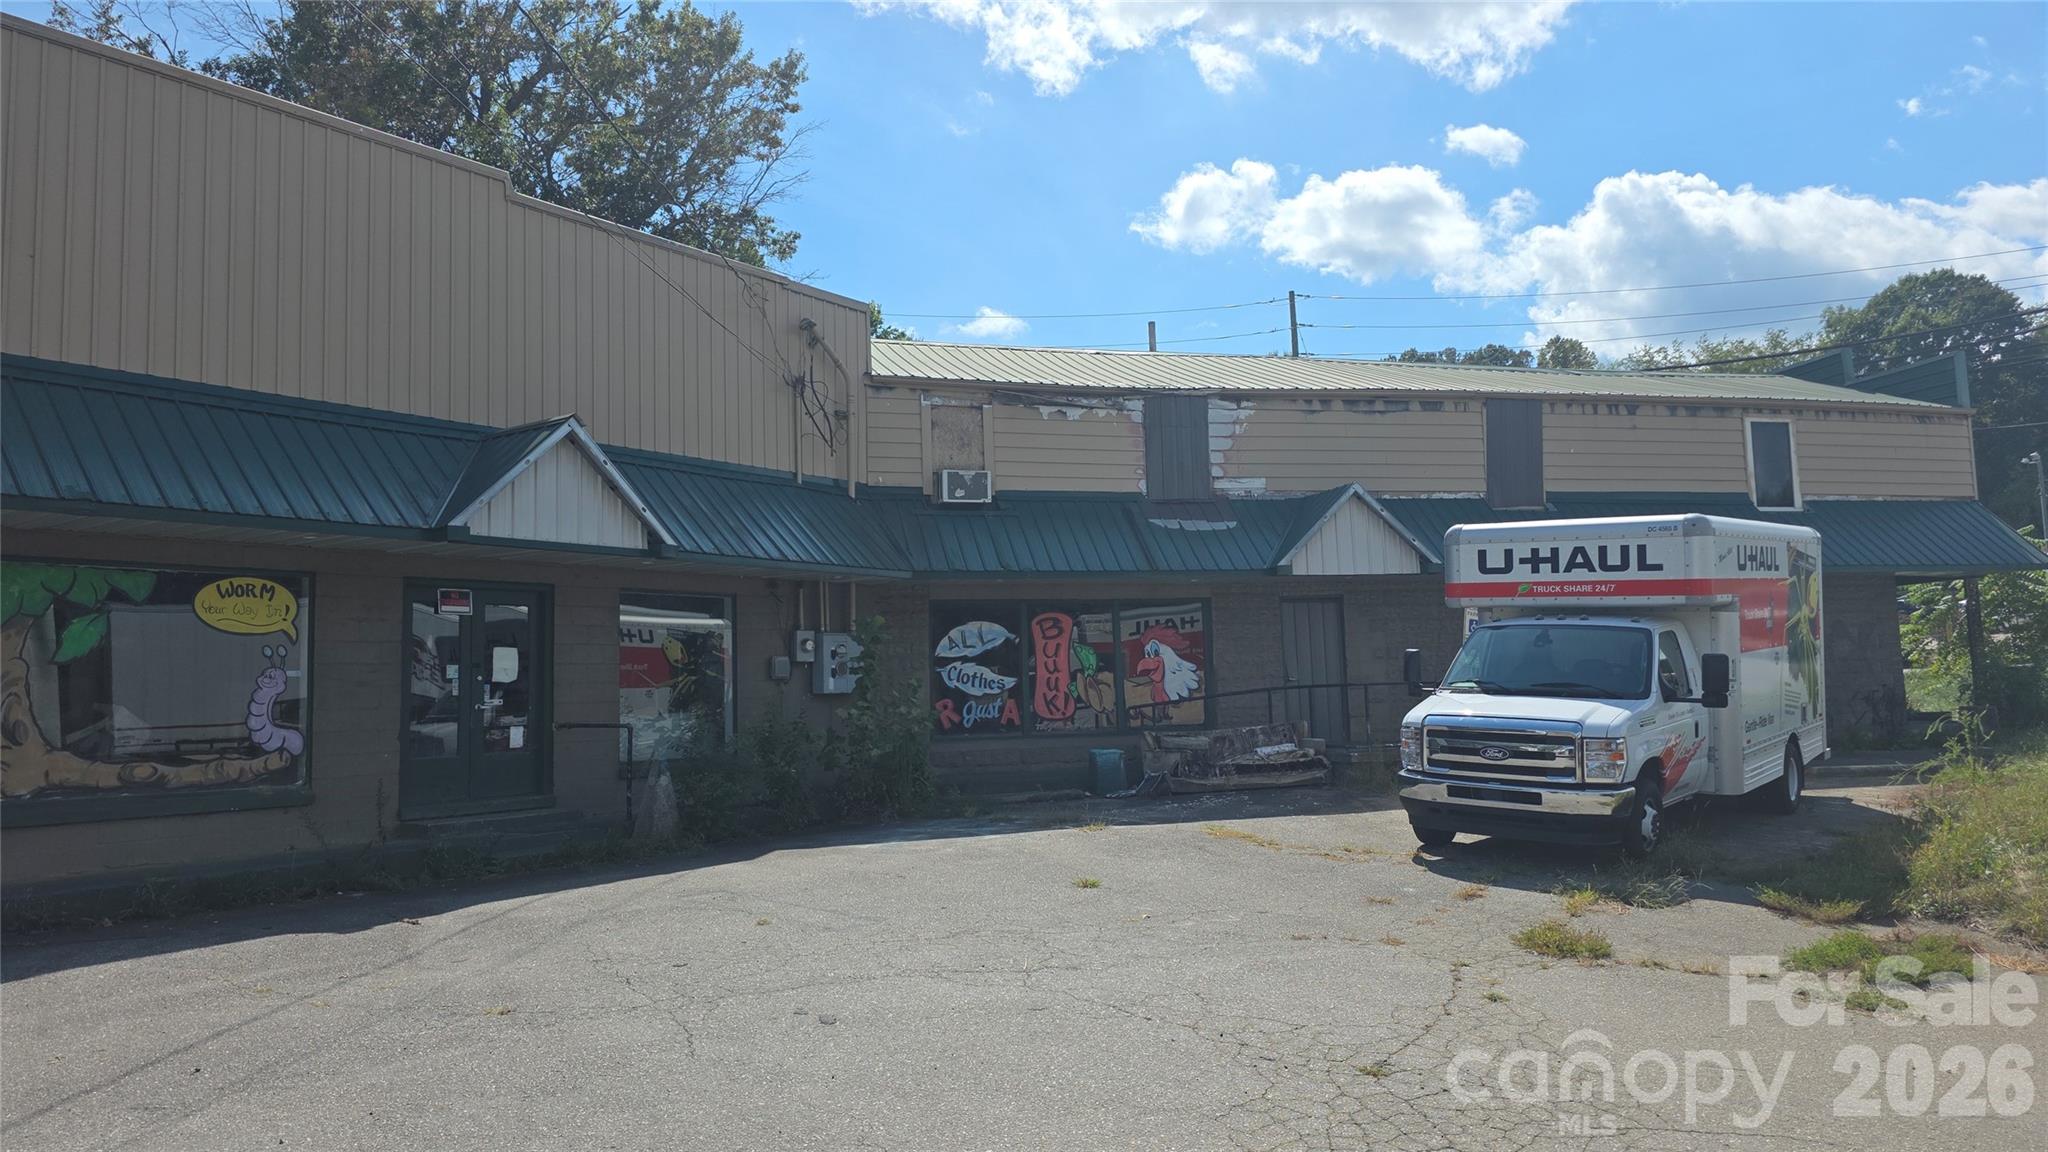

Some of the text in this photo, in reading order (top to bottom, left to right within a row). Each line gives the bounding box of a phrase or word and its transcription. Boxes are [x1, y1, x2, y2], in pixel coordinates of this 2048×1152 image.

[1477, 544, 1664, 575] U-HAUL
[1737, 544, 1779, 572] U-HAUL
[216, 580, 276, 602] WORM
[1532, 584, 1616, 593] TRUCK SHARE 24/7
[233, 602, 258, 620] Way
[265, 603, 290, 621] In!
[947, 623, 998, 651] ALL
[947, 665, 1006, 690] Clothes
[935, 698, 962, 730] R
[1001, 698, 1021, 726] A
